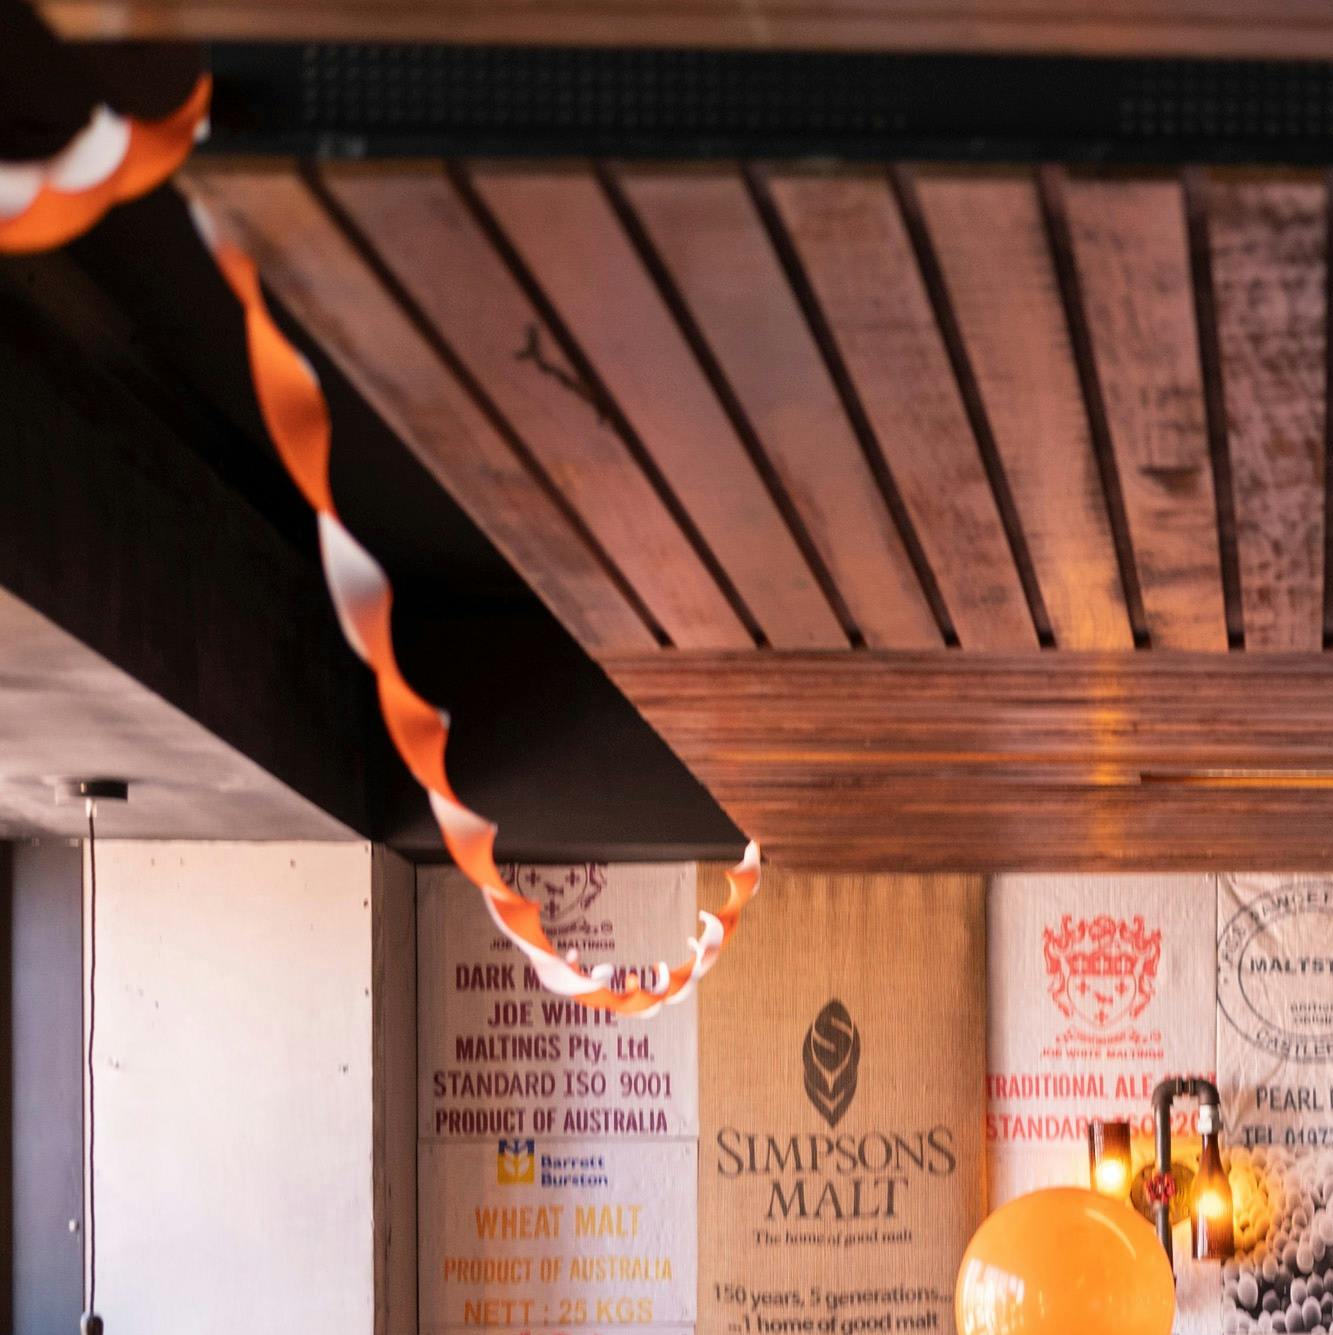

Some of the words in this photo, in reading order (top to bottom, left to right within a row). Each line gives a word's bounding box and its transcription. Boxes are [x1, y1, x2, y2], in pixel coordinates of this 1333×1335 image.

[455, 965, 515, 992] DARK
[487, 1002, 535, 1027] JOE
[455, 1036, 561, 1061] MALTINGS
[569, 1036, 607, 1063] Pty.
[616, 1036, 655, 1061] Ltd.
[434, 1073, 555, 1098] STANDARD
[563, 1073, 606, 1098] ISO
[620, 1071, 672, 1098] 9001
[986, 1073, 1109, 1099] TRADITIONAL
[1115, 1074, 1153, 1098] ALE
[1256, 1088, 1324, 1111] PEARL
[435, 1109, 527, 1134] PRODUCT
[533, 1109, 556, 1133] OF
[563, 1109, 668, 1134] AUSTRALIA
[541, 1156, 605, 1170] Barrett
[716, 1126, 957, 1178] SIMPSONS
[541, 1173, 608, 1188] Burston
[766, 1177, 909, 1220] MALT
[475, 1205, 564, 1240] WHEAT
[575, 1205, 641, 1239] MALT
[443, 1259, 529, 1284] PRODUCT
[535, 1259, 562, 1283] OF
[569, 1258, 672, 1282] AUSTRALIA
[713, 1286, 747, 1304] 150
[811, 1287, 821, 1304] 5
[464, 1301, 536, 1326] NETT
[558, 1300, 588, 1323] 25
[602, 1300, 653, 1323] KGS
[756, 1316, 813, 1334] home
[817, 1315, 839, 1334] of
[896, 1313, 938, 1332] malt
